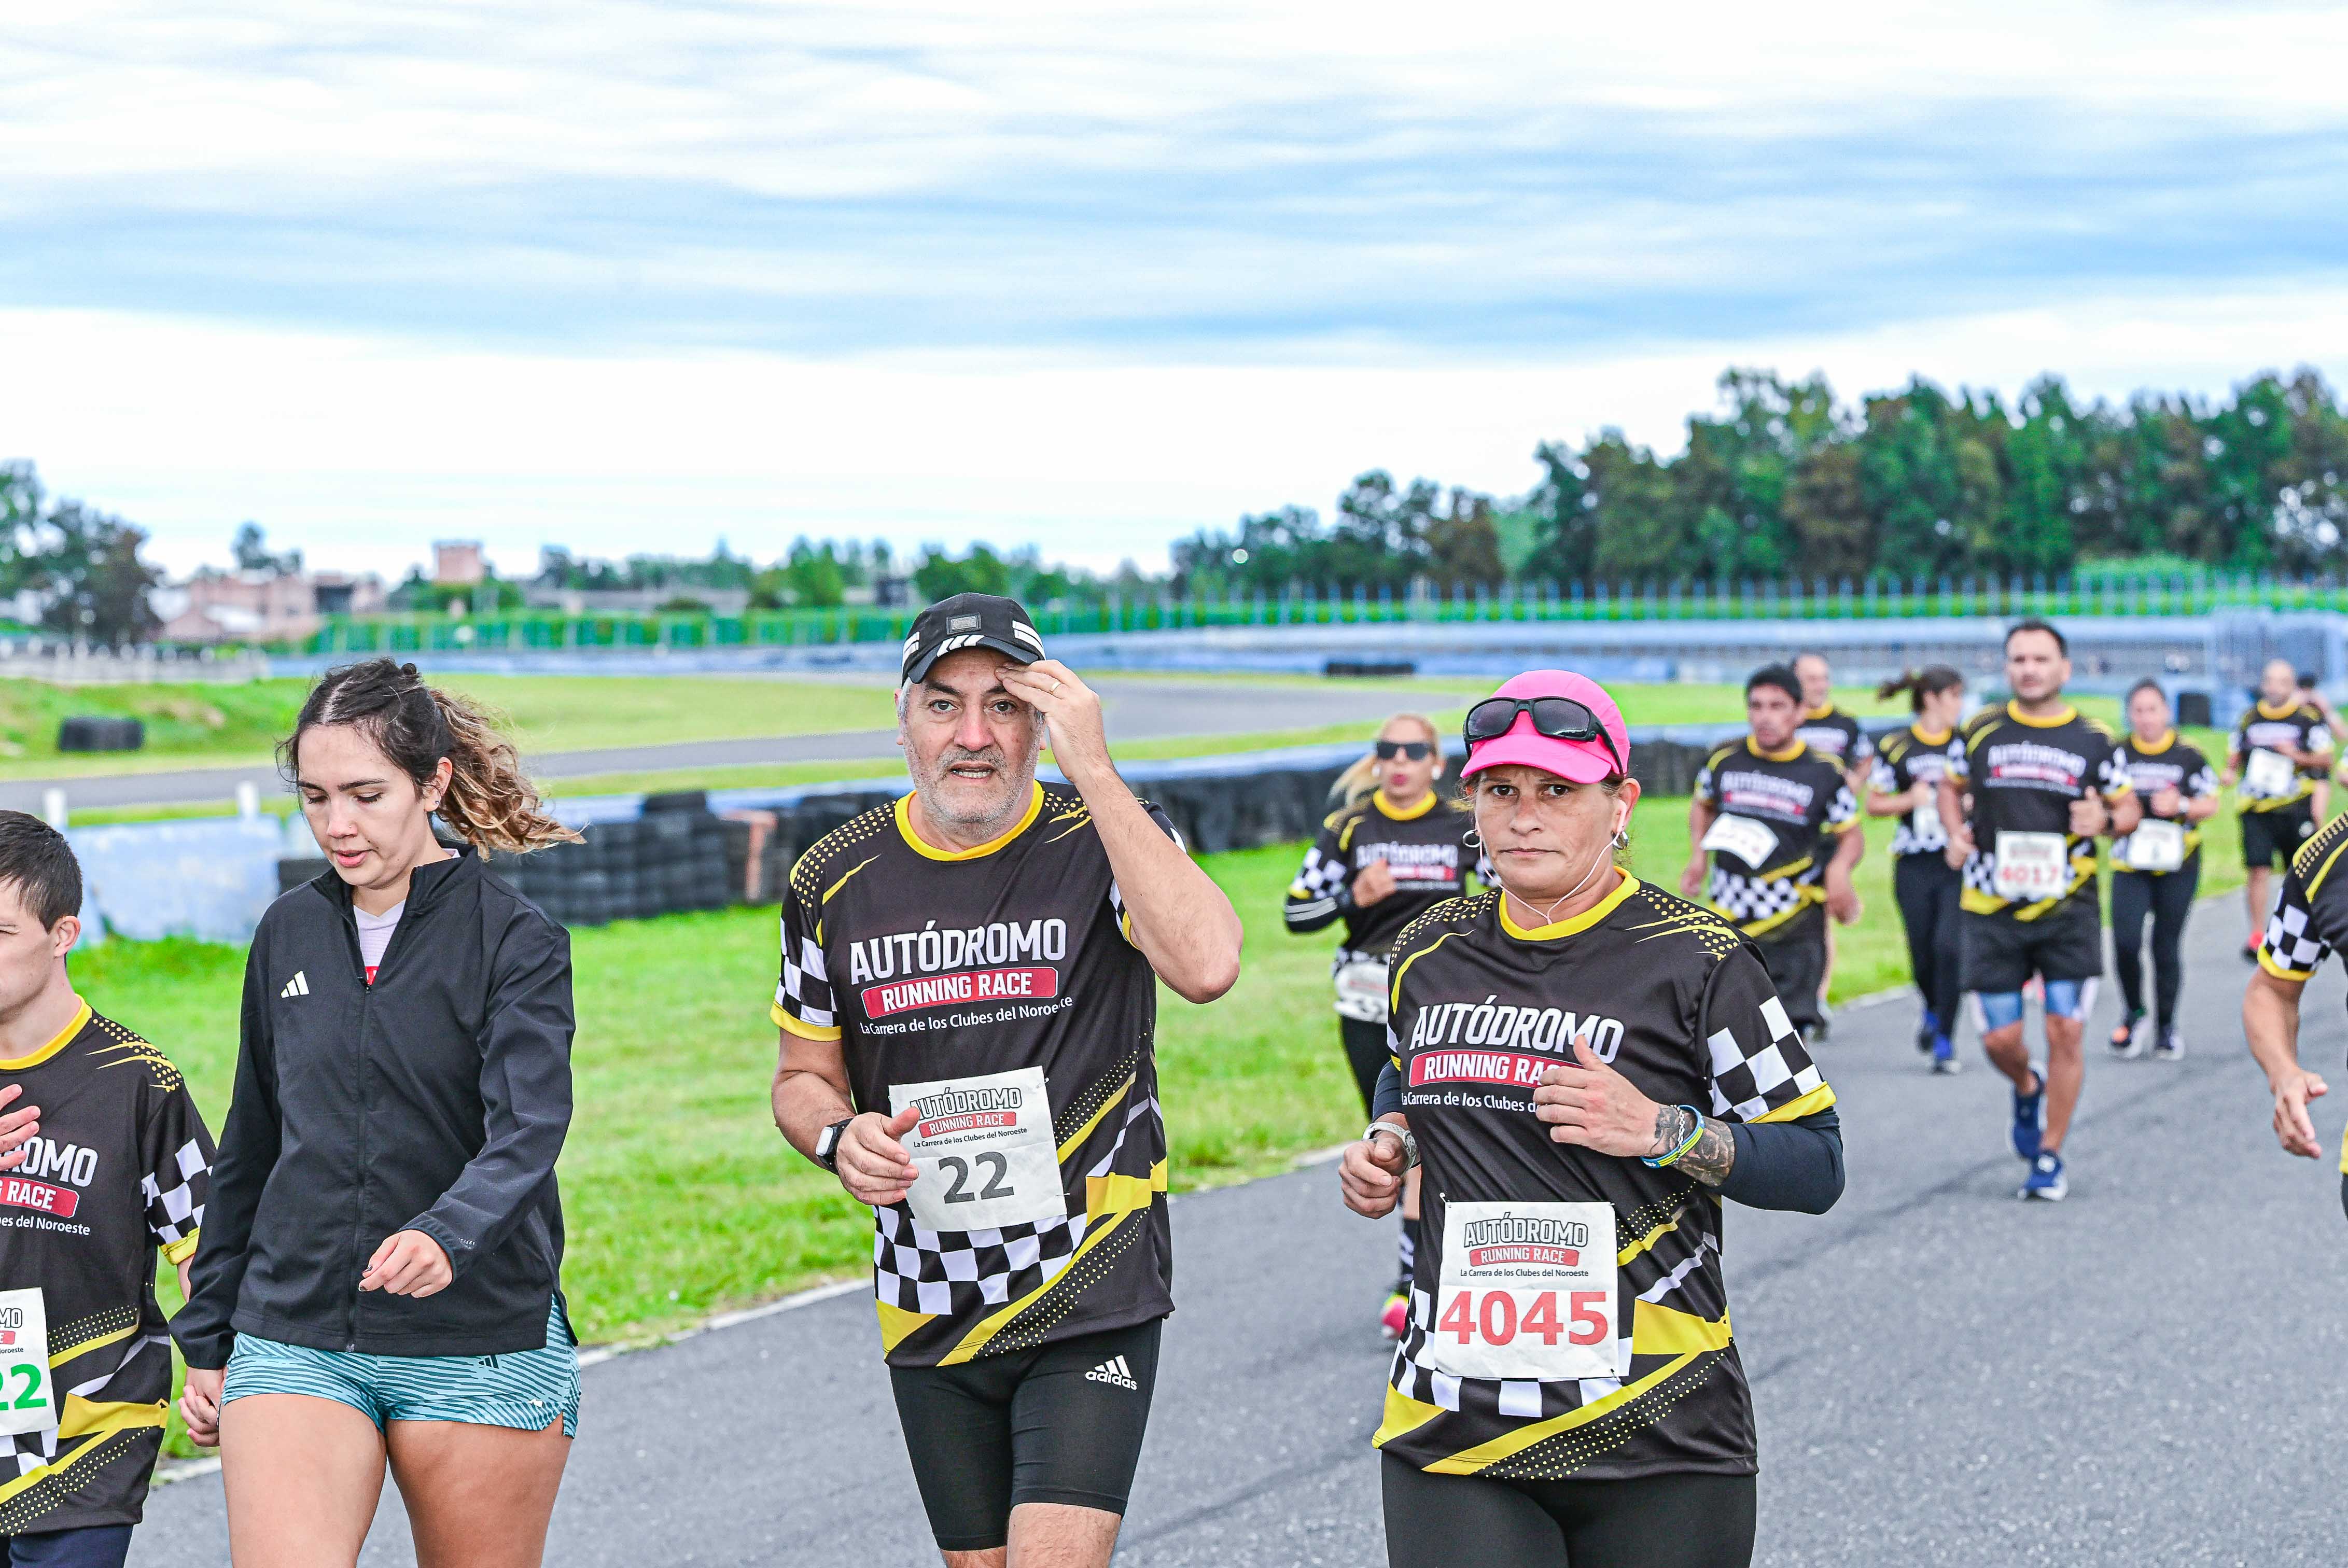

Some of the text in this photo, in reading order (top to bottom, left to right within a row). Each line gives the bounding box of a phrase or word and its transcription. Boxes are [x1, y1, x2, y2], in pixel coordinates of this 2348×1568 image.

[850, 918, 1067, 985] AUTÓDROMO
[880, 972, 1032, 1013] RUNNING RACE
[860, 997, 1073, 1034] La Carrera de los Clubes del Noroete
[1408, 995, 1625, 1065] AUTÓDROMO
[1423, 1053, 1560, 1086] RUNNING RA
[1407, 1091, 1441, 1105] Carrera
[1444, 1091, 1460, 1105] de
[1462, 1092, 1482, 1108] los
[1484, 1095, 1525, 1112] Clubes
[928, 1114, 1004, 1135] RUNNING RACE
[998, 1128, 1027, 1137] Noroeste
[938, 1151, 1015, 1204] 22
[6, 1180, 57, 1210] RACE
[16, 1215, 34, 1228] del
[36, 1217, 91, 1236] Noroeste
[1463, 1211, 1588, 1248] AUTÓDROMO
[1480, 1247, 1566, 1264] RUNNING RACE
[1439, 1290, 1608, 1346] 4045
[1085, 1370, 1137, 1391] adidas
